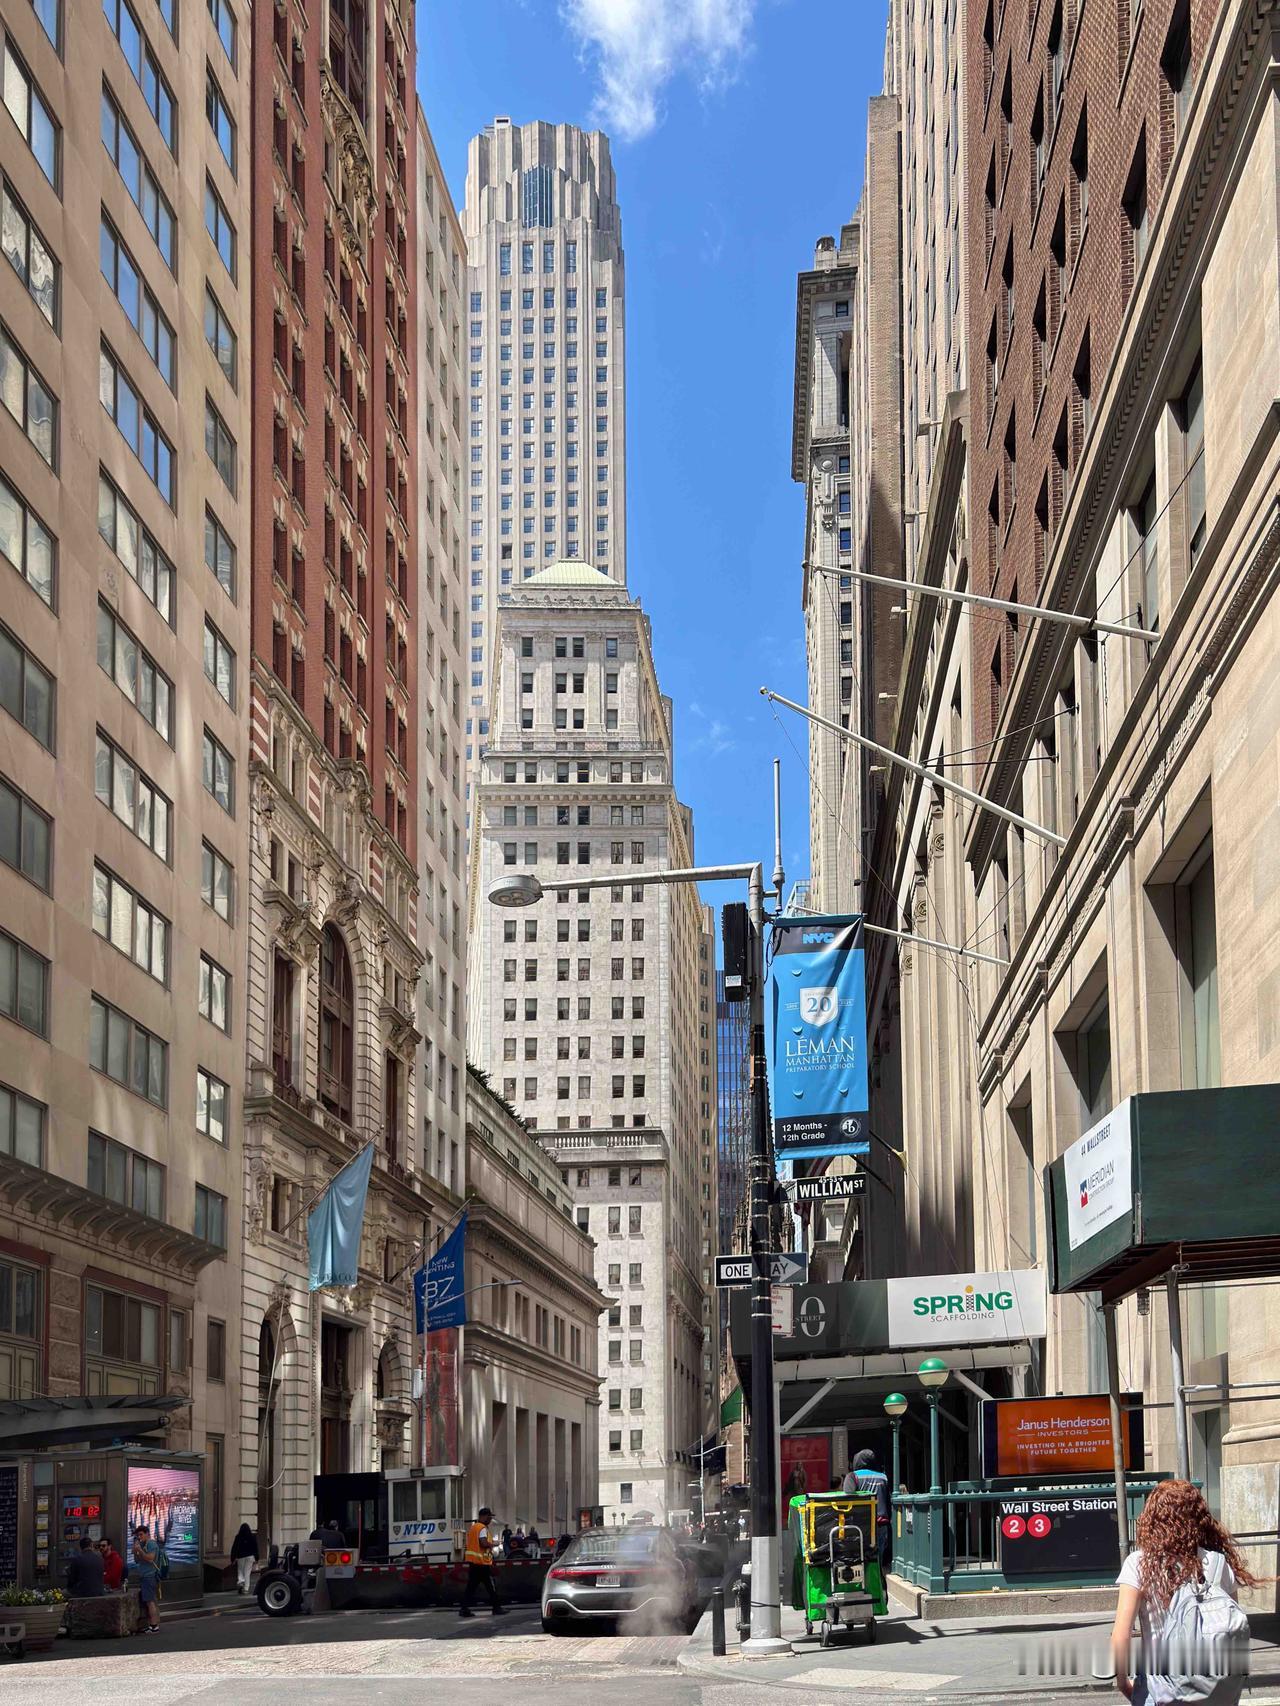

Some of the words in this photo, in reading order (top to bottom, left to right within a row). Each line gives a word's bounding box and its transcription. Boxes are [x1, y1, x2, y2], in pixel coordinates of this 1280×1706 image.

[803, 933, 834, 944] NYC
[807, 996, 832, 1013] 20
[785, 1035, 855, 1057] LÉMAN
[785, 1053, 855, 1067] MANHATTAN
[785, 1064, 827, 1073] PREPARATORY
[829, 1062, 855, 1070] SCHOOL
[782, 1124, 792, 1132] 12
[793, 1122, 823, 1131] Months
[782, 1133, 800, 1142] 12th
[801, 1132, 825, 1140] Grade
[1087, 1160, 1115, 1191] MERIDIAN
[799, 1180, 853, 1198] WILLIAM
[854, 1179, 864, 1188] ST
[725, 1264, 750, 1277] ONE
[771, 1262, 789, 1275] AY
[913, 1284, 1013, 1316] SPRING
[930, 1311, 995, 1322] SCAFFOLDING
[1017, 1419, 1049, 1430] Janus
[1050, 1416, 1110, 1429] Henderson
[1037, 1429, 1089, 1437] INVESTORS
[1017, 1441, 1055, 1449] INVESTING
[1030, 1448, 1057, 1456] FUTURE
[173, 1505, 196, 1515] MORMON
[1001, 1502, 1029, 1514] Wall
[1032, 1501, 1070, 1513] Street
[1072, 1499, 1117, 1511] Station
[403, 1522, 436, 1536] NYPD
[1009, 1519, 1020, 1533] 2
[1034, 1518, 1045, 1533] 3
